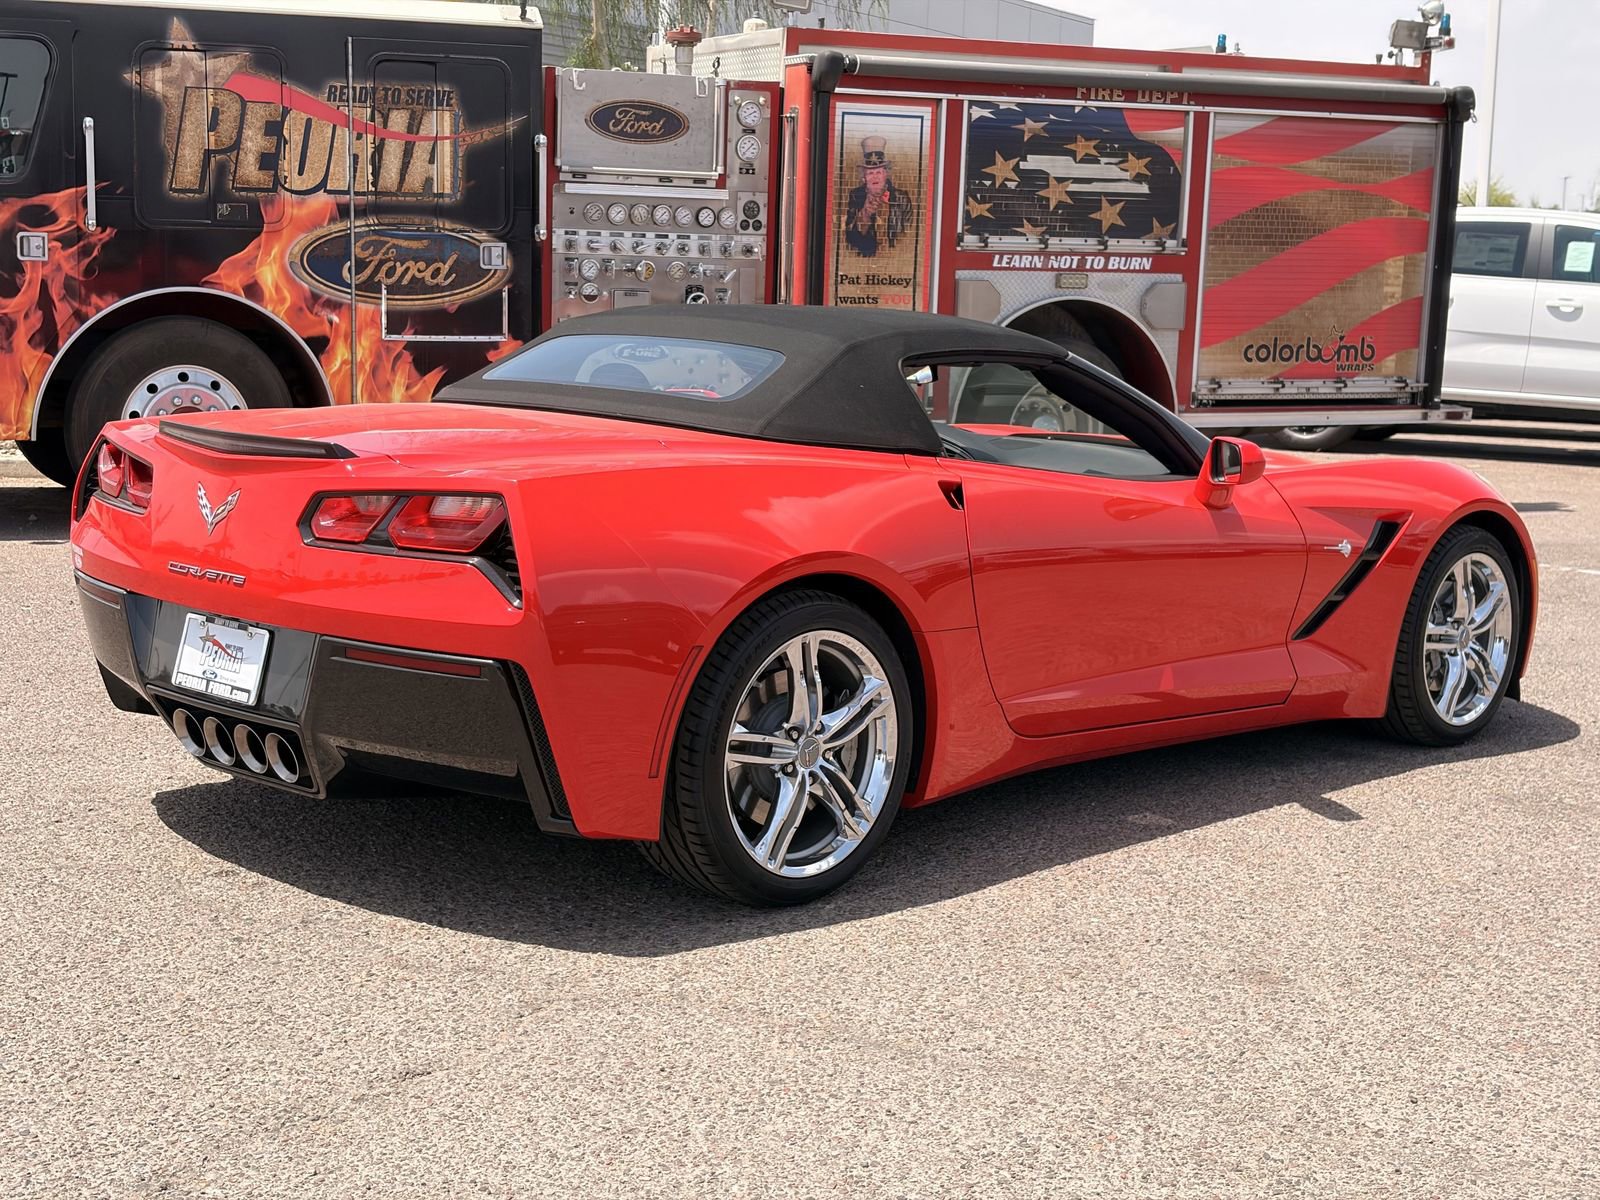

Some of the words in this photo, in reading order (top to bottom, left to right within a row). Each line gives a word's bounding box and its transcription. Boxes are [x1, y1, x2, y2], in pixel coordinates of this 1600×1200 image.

[326, 84, 376, 103] READY
[382, 86, 401, 105] TO
[405, 87, 455, 108] SERVE
[1076, 87, 1126, 102] FIRE
[609, 107, 667, 136] Ford
[169, 86, 457, 196] PEORIA
[342, 235, 460, 286] Ford
[992, 254, 1044, 268] LEARN
[1048, 255, 1082, 269] NOT
[1085, 255, 1106, 270] TO
[1108, 256, 1153, 270] BURN
[839, 274, 861, 285] Pat
[864, 273, 913, 289] Hickey
[839, 294, 880, 305] wants
[1243, 335, 1376, 364] colorbomb
[1336, 363, 1376, 372] WRAPS
[168, 561, 246, 586] CORVETTE
[200, 641, 244, 673] PEORIA
[175, 672, 207, 692] PEORIA
